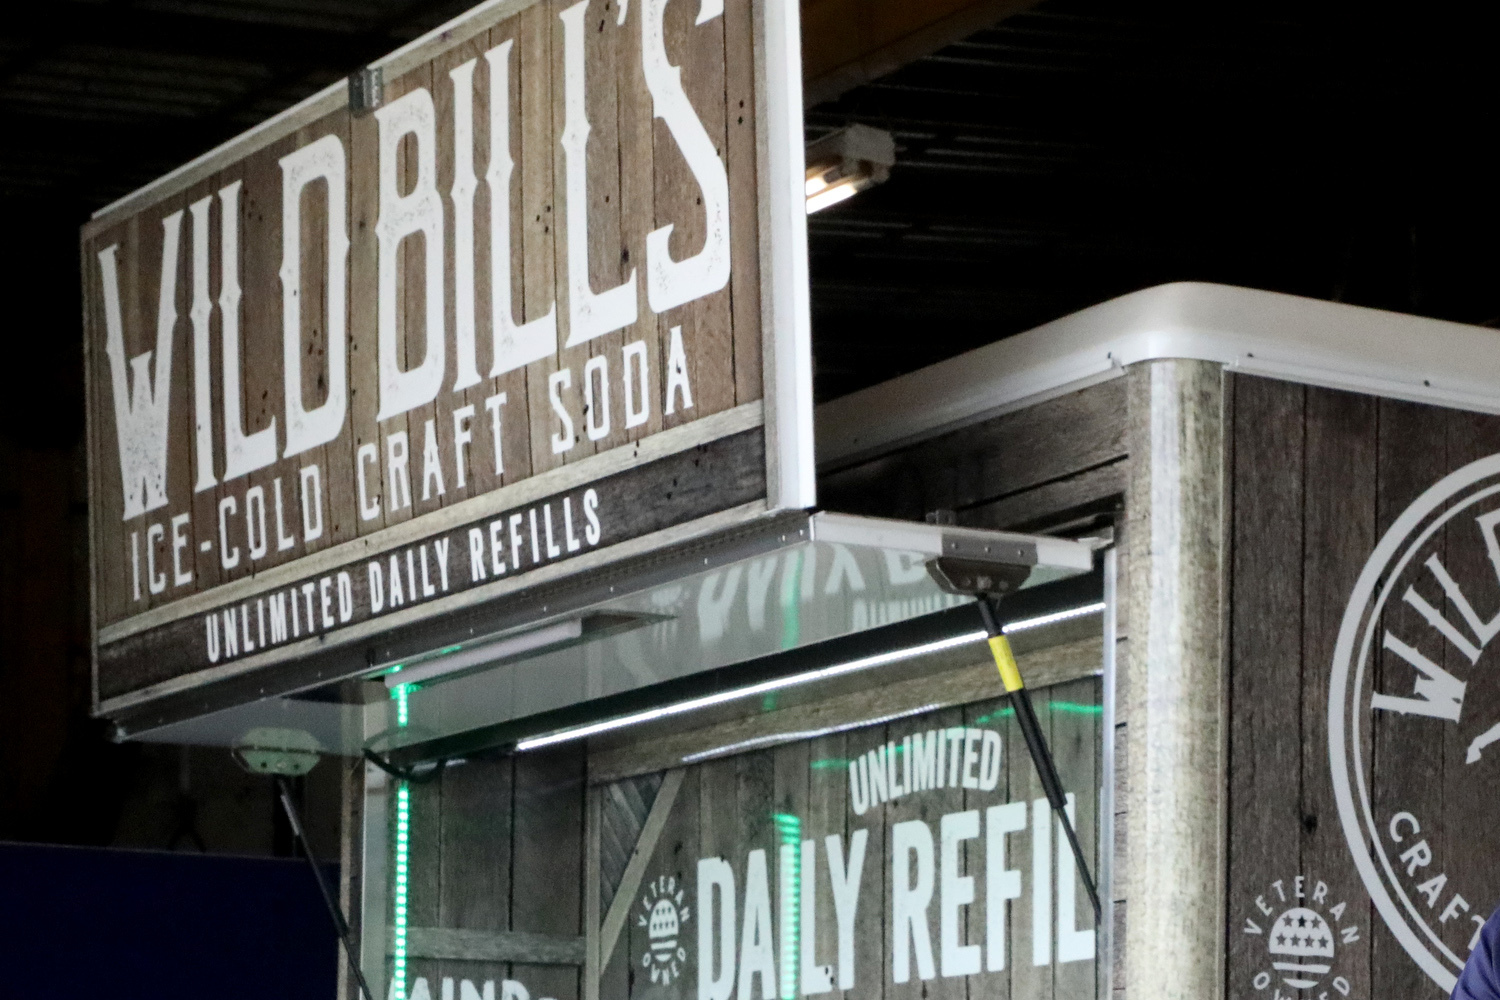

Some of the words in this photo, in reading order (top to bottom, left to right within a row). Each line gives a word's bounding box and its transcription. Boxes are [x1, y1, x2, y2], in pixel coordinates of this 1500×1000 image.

[99, 133, 350, 521] WILD
[374, 0, 731, 421] BILL'S
[131, 464, 322, 601] ICE-COLD
[357, 392, 507, 521] CRAFT
[550, 326, 694, 455] SODA
[206, 569, 354, 663] UNLIMITED
[369, 537, 450, 613] DAILY
[470, 489, 602, 582] REFILLS
[849, 728, 1002, 815] UNLIMITED
[638, 875, 690, 928] VETERAN
[1244, 876, 1360, 945] VETERAN
[643, 947, 686, 987] OWNED
